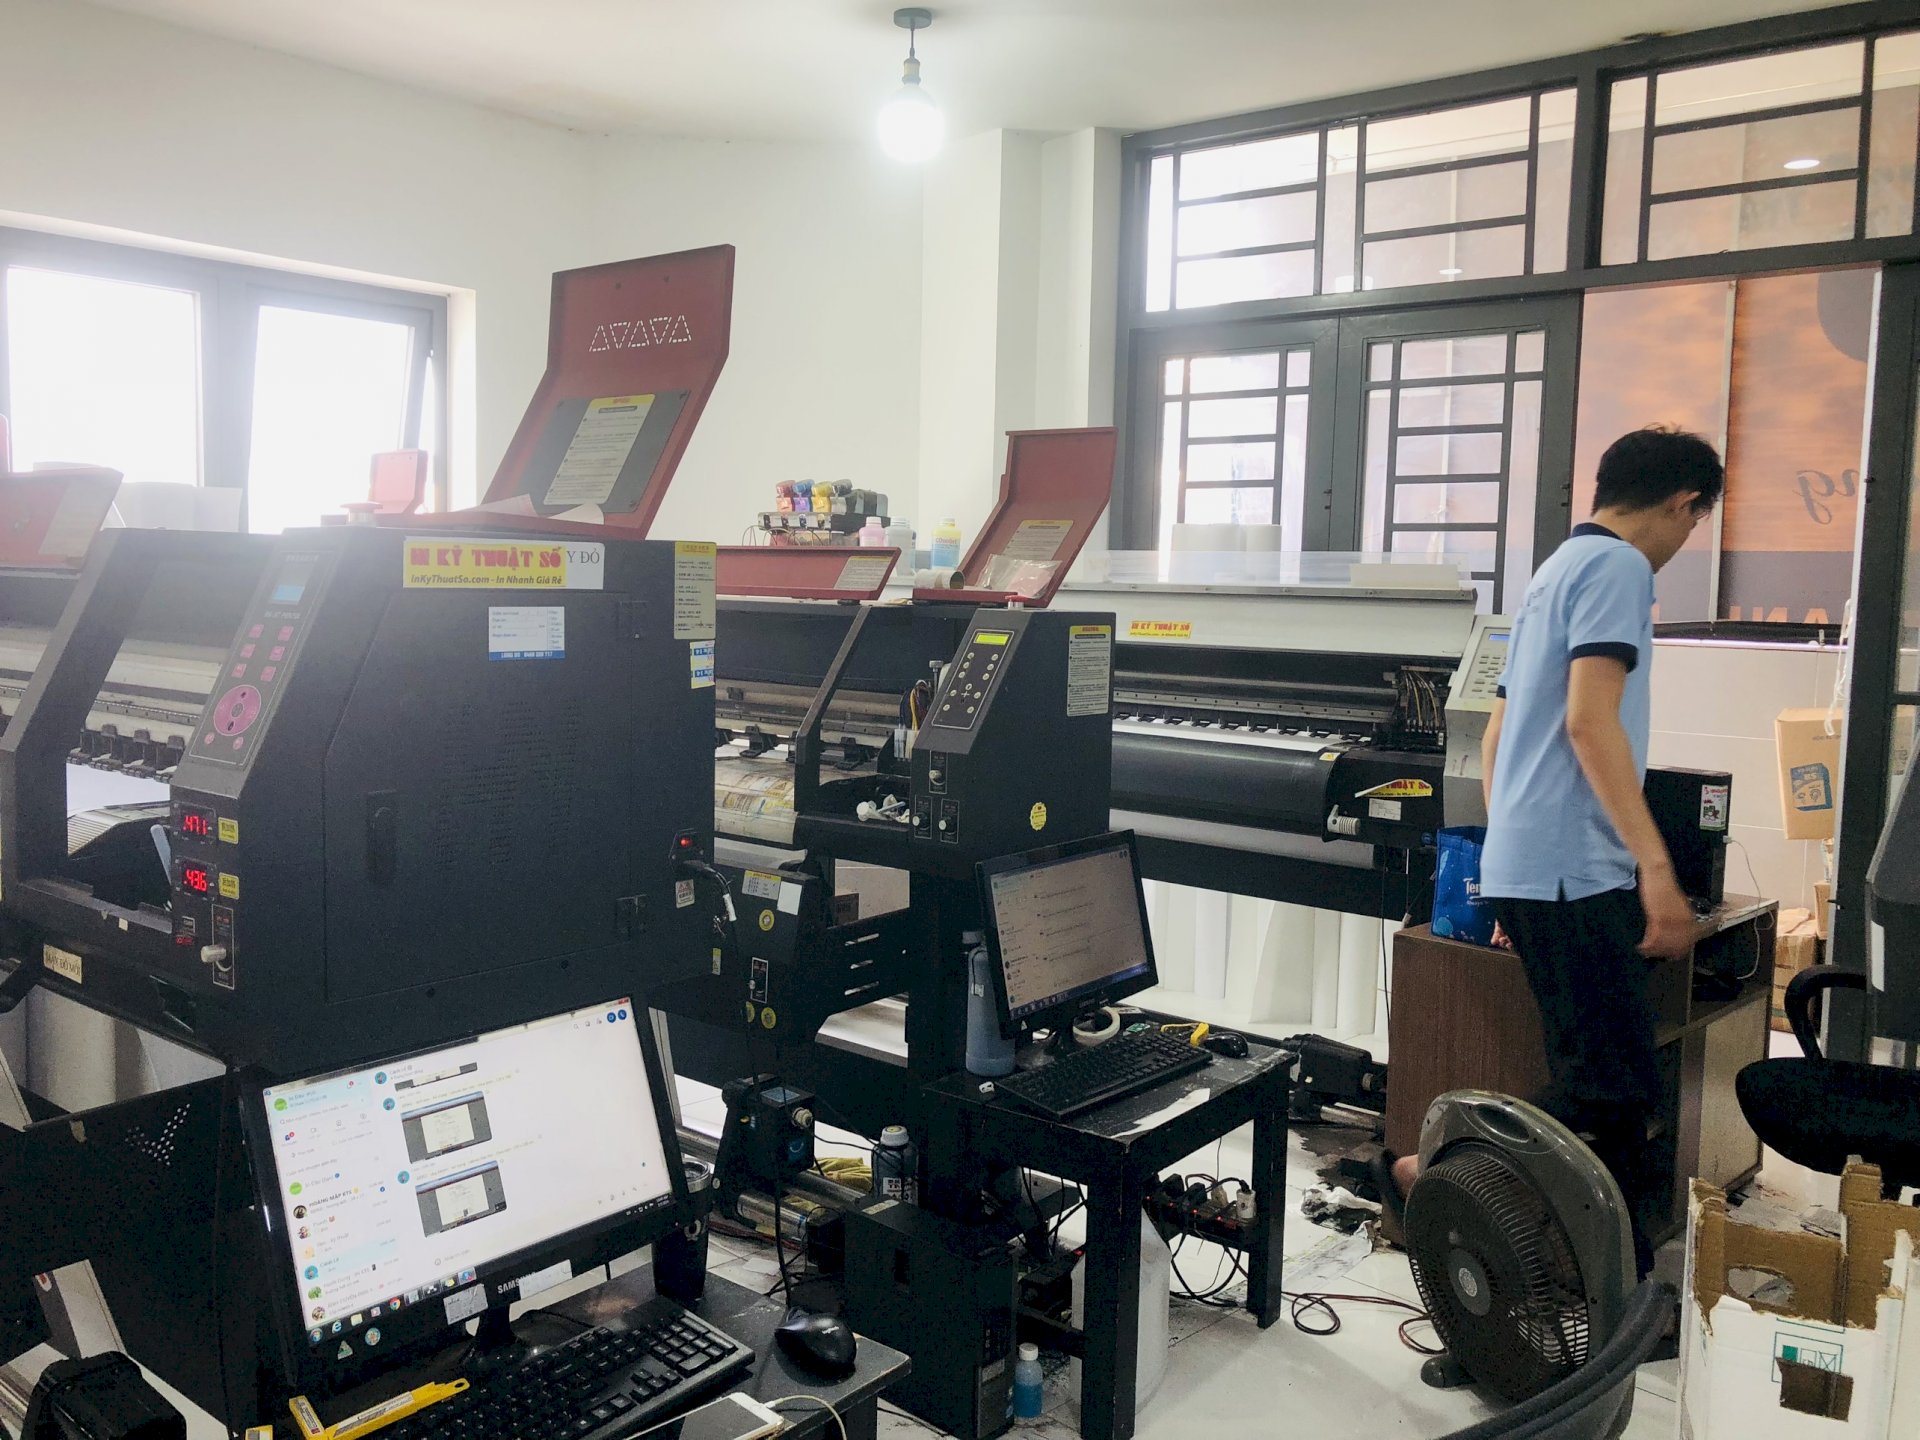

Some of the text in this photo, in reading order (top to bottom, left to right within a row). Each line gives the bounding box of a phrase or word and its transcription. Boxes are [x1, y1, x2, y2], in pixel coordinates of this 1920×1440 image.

[472, 547, 533, 571] THUẬT
[411, 575, 490, 585] InKyThuatSo.com
[506, 576, 534, 585] Nhanh
